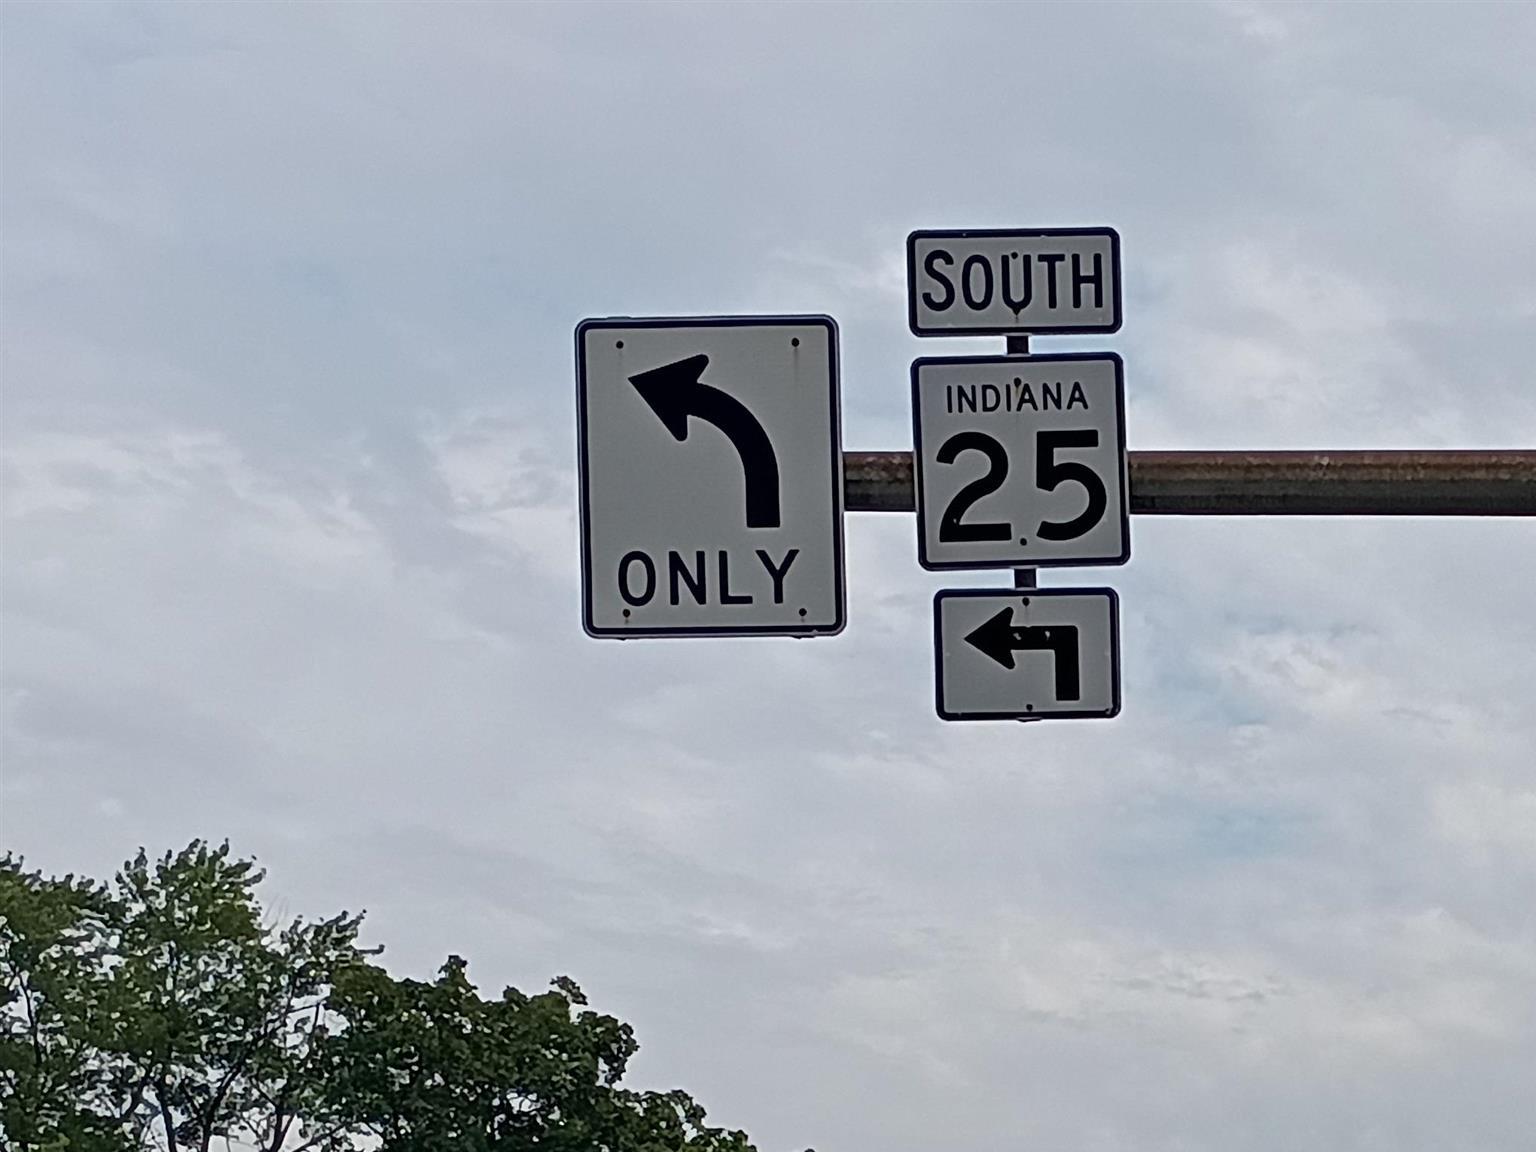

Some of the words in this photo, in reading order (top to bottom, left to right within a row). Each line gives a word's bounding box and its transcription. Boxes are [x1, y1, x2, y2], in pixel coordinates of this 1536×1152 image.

[921, 249, 1104, 312] SOUTH
[946, 380, 1089, 413] INDIANA
[935, 429, 1108, 543] 25
[618, 548, 800, 607] ONLY
